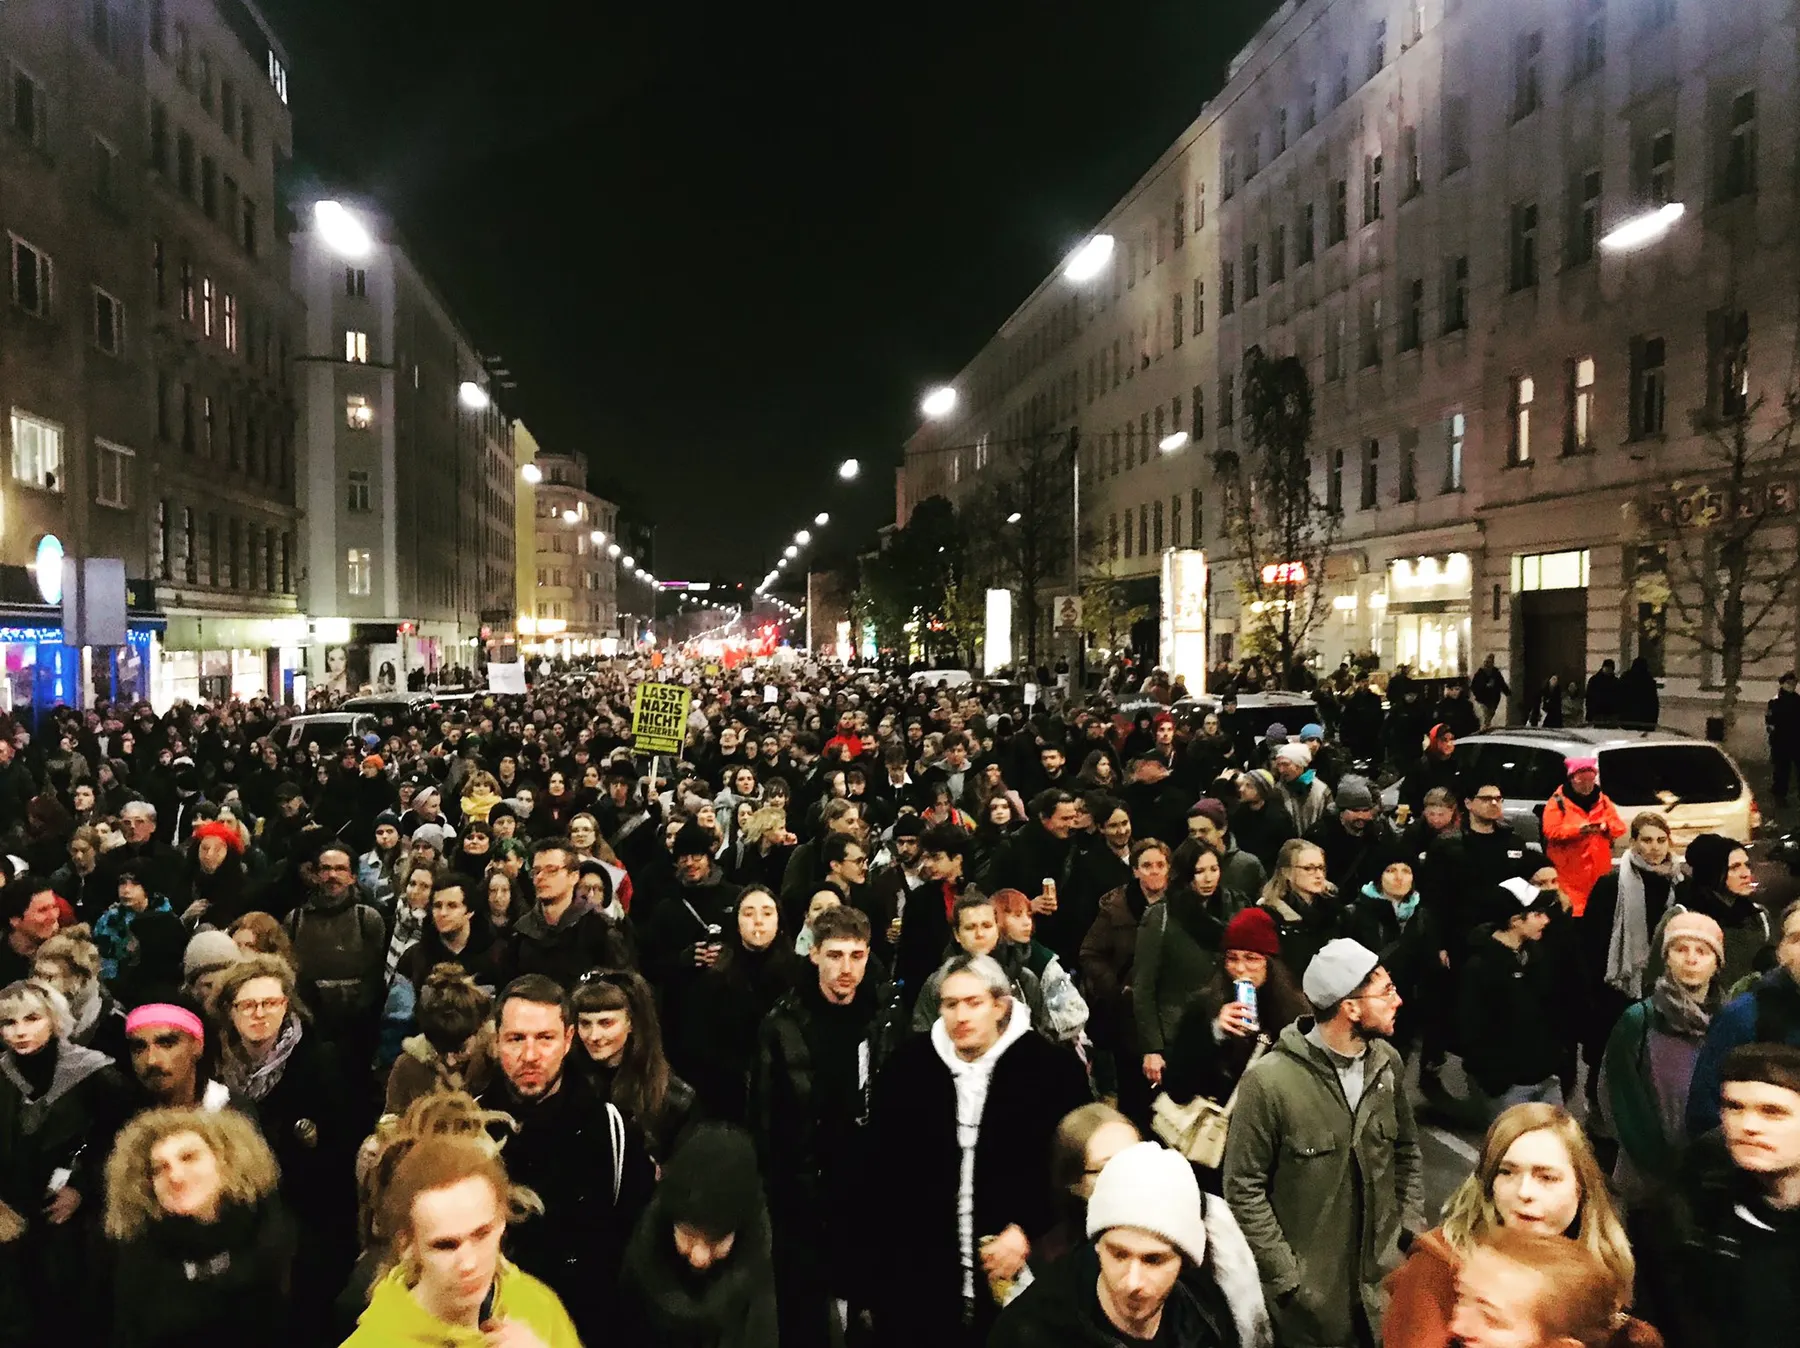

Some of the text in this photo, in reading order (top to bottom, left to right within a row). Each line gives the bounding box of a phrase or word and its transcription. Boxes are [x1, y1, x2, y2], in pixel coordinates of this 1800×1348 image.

[642, 685, 685, 702] LASST
[641, 698, 683, 715] NAZIS
[639, 712, 682, 728] NICHT
[637, 725, 679, 737] REGIEREN
